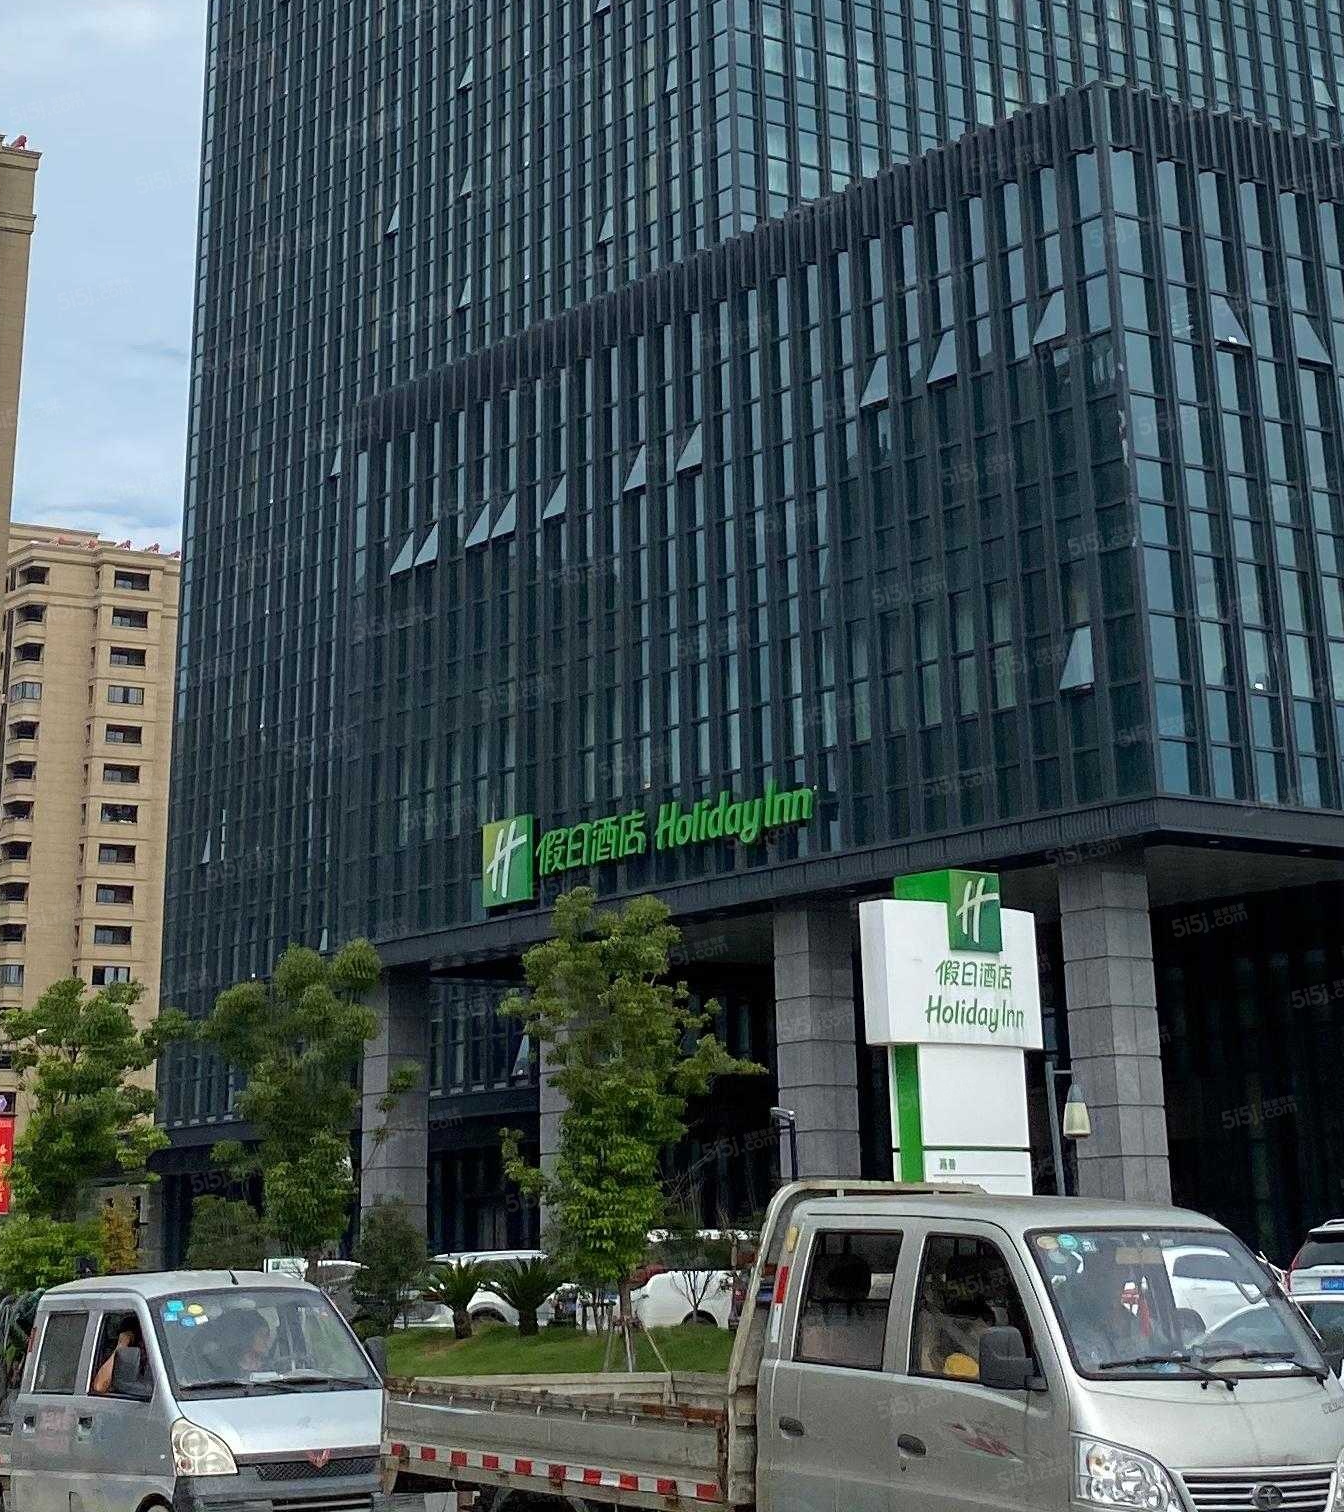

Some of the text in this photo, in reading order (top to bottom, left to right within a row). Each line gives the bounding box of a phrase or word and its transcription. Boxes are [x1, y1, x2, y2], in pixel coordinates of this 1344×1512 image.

[535, 783, 814, 877] 假日酒店 Holiday Inn
[935, 959, 1013, 990] 假日酒店
[924, 994, 1025, 1033] Holiday Inn
